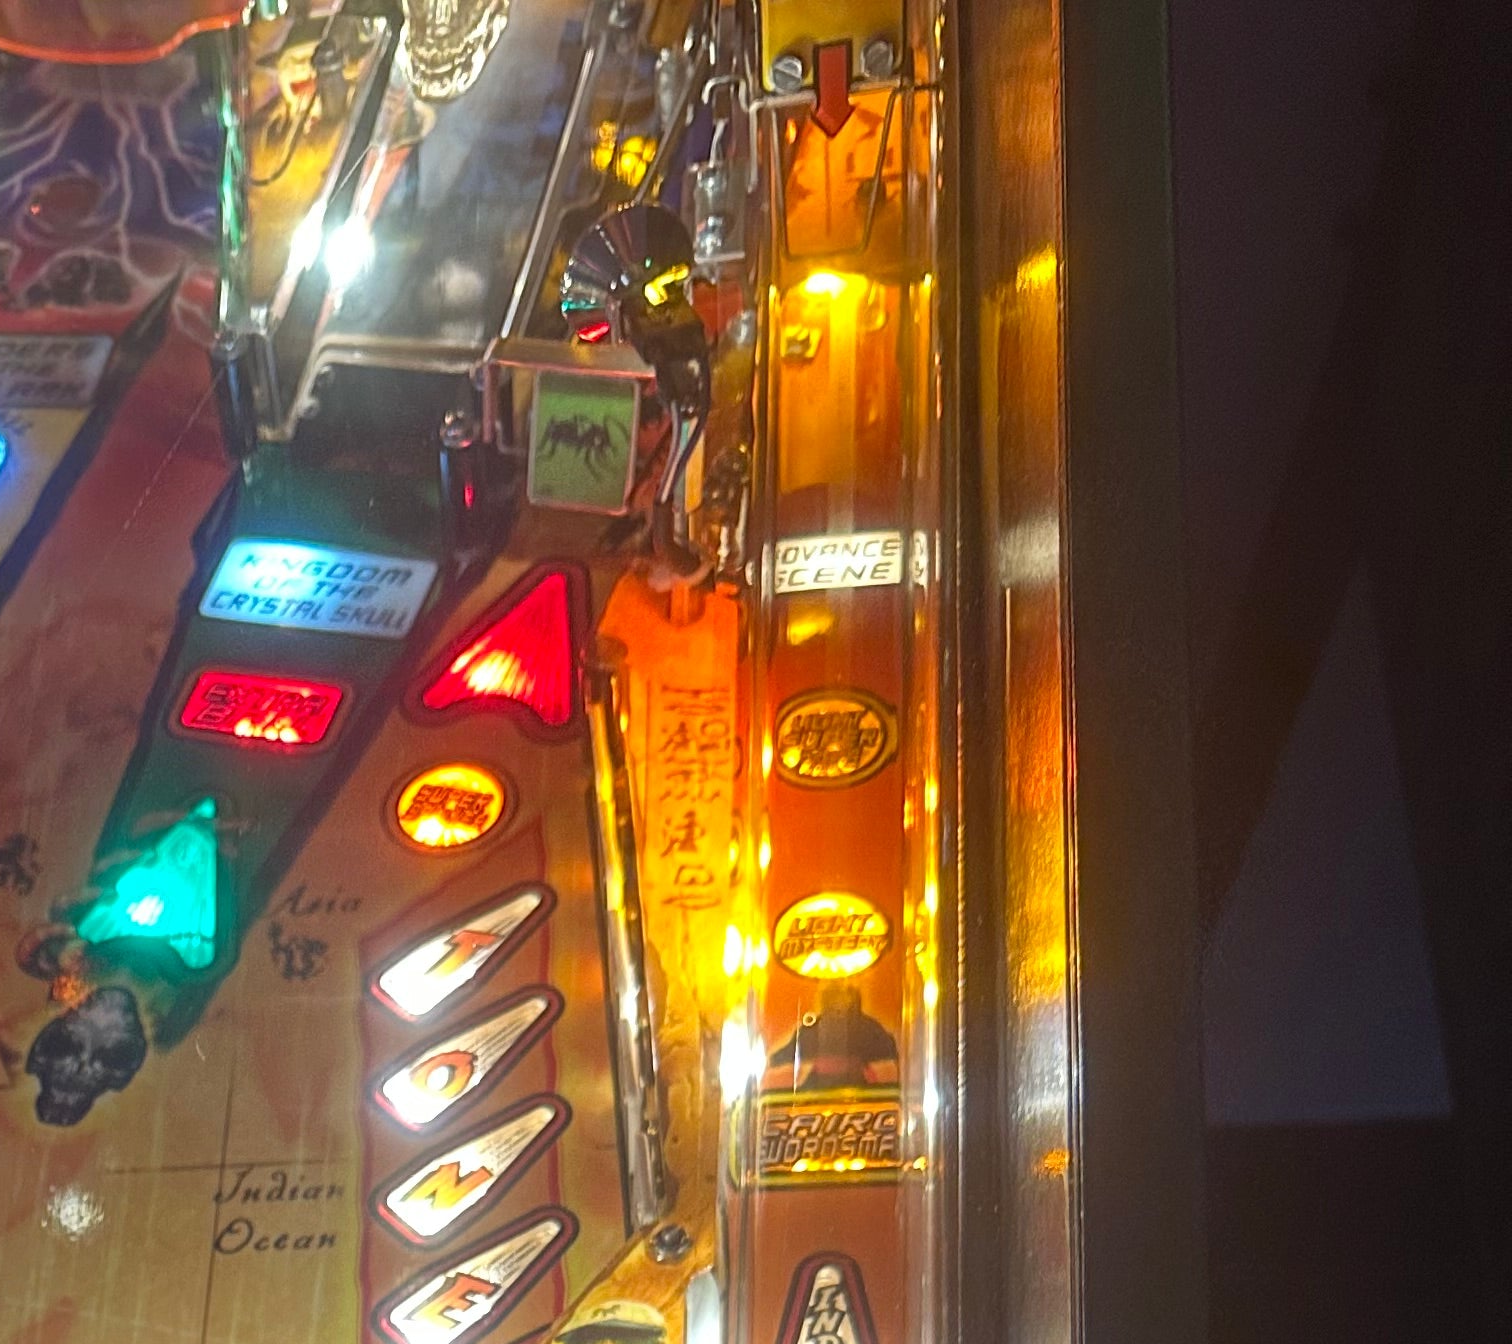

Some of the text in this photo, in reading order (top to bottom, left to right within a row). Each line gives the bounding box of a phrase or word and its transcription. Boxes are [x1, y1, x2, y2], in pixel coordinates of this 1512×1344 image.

[775, 538, 902, 565] DVANCE
[210, 591, 411, 632] CRYSTAL SKULL
[789, 914, 874, 934] LIGHT
[212, 1167, 347, 1206] Indian
[213, 1217, 338, 1256] Ocean
